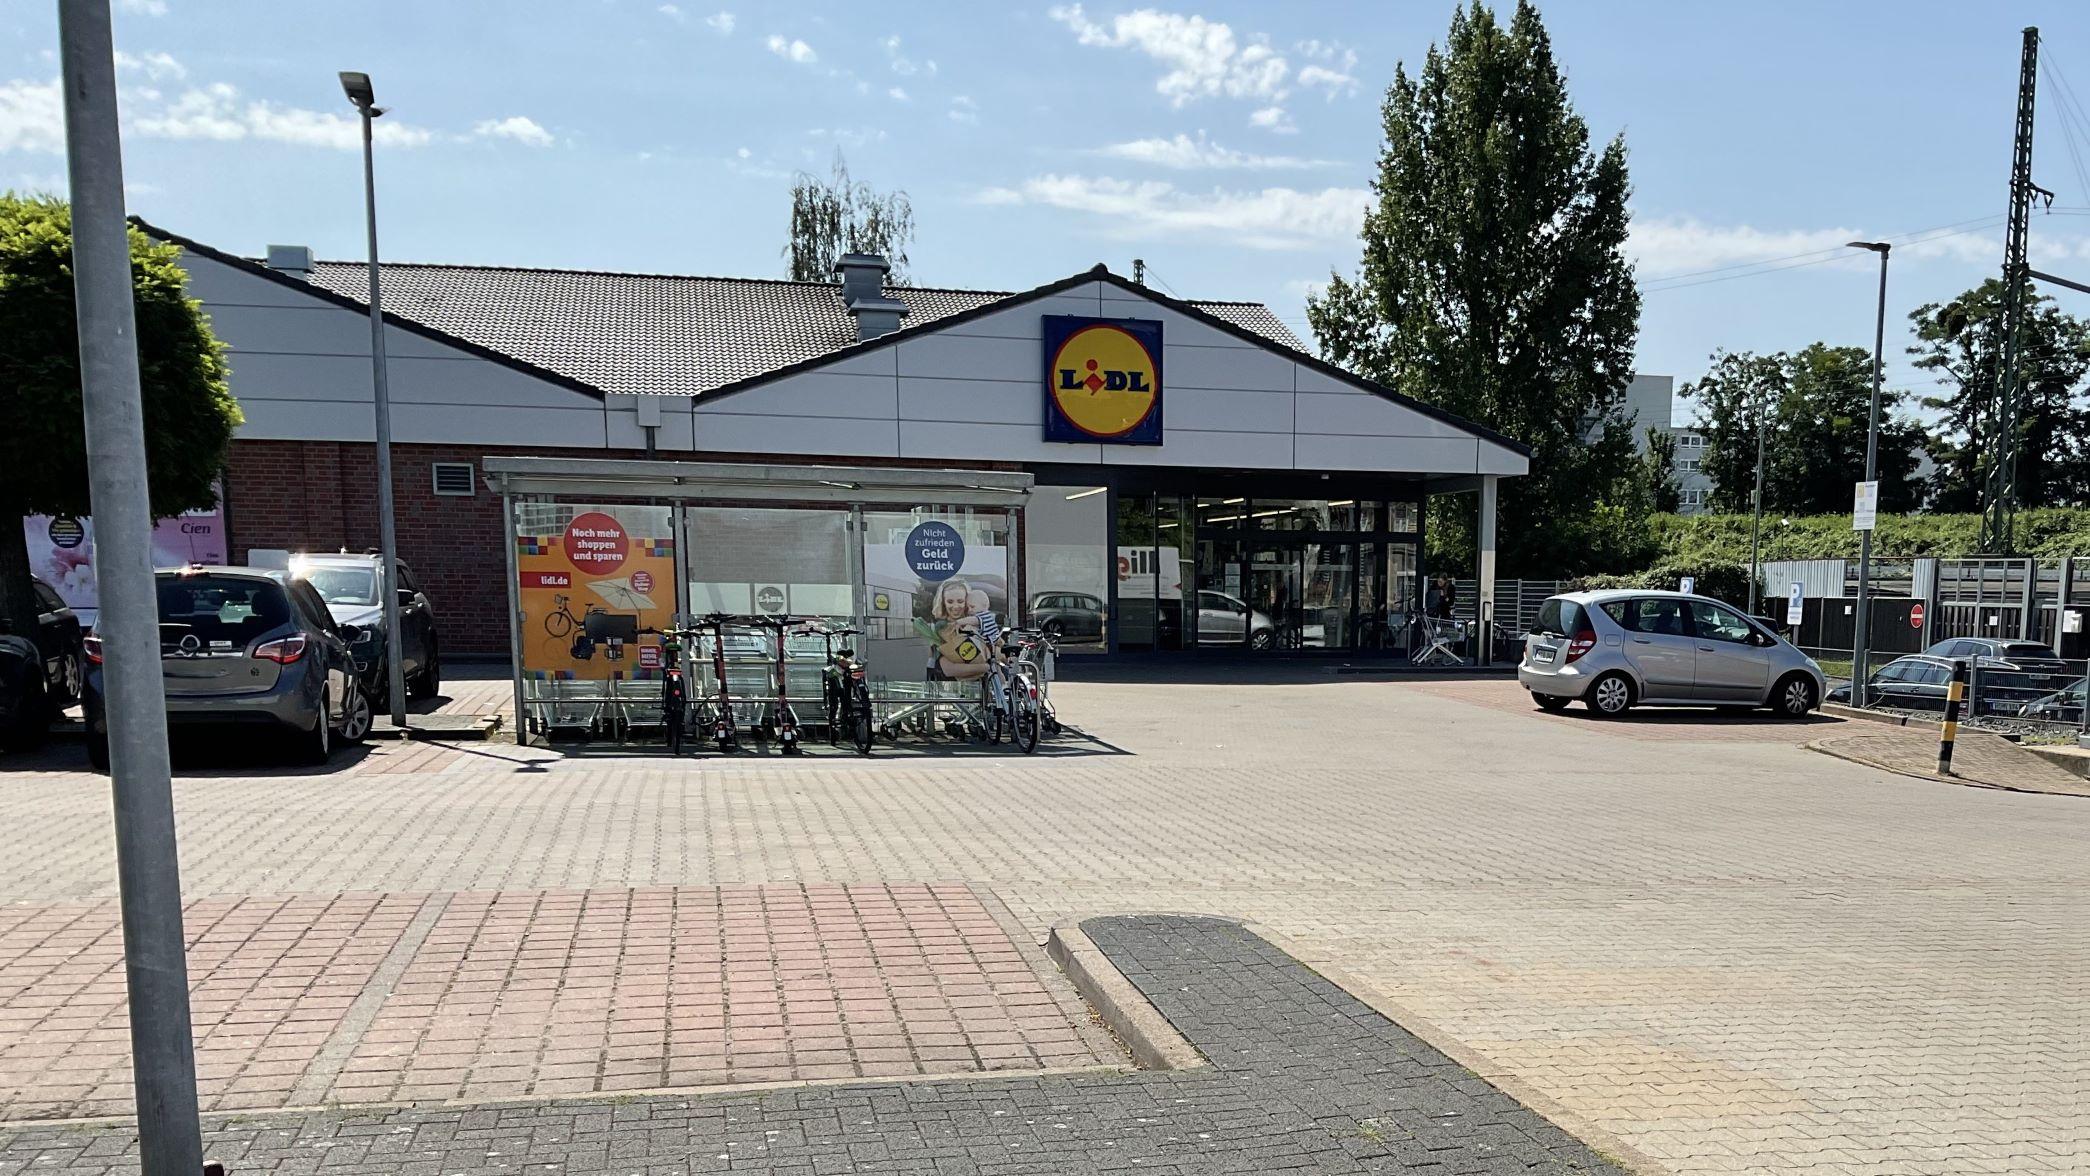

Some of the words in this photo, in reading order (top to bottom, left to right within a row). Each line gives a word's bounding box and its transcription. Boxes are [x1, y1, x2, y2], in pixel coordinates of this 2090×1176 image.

[1059, 359, 1150, 396] LIDL
[181, 522, 211, 534] Cien
[572, 528, 596, 538] Noch
[597, 528, 621, 538] mehr
[923, 529, 946, 537] Nicht
[577, 540, 616, 550] shoppen
[915, 538, 955, 547] zufrieden
[573, 551, 592, 560] und
[593, 553, 623, 562] sparen
[921, 548, 948, 559] Geld
[916, 560, 954, 571] zurück
[541, 575, 568, 585] lidl.de
[1790, 583, 1800, 607] P
